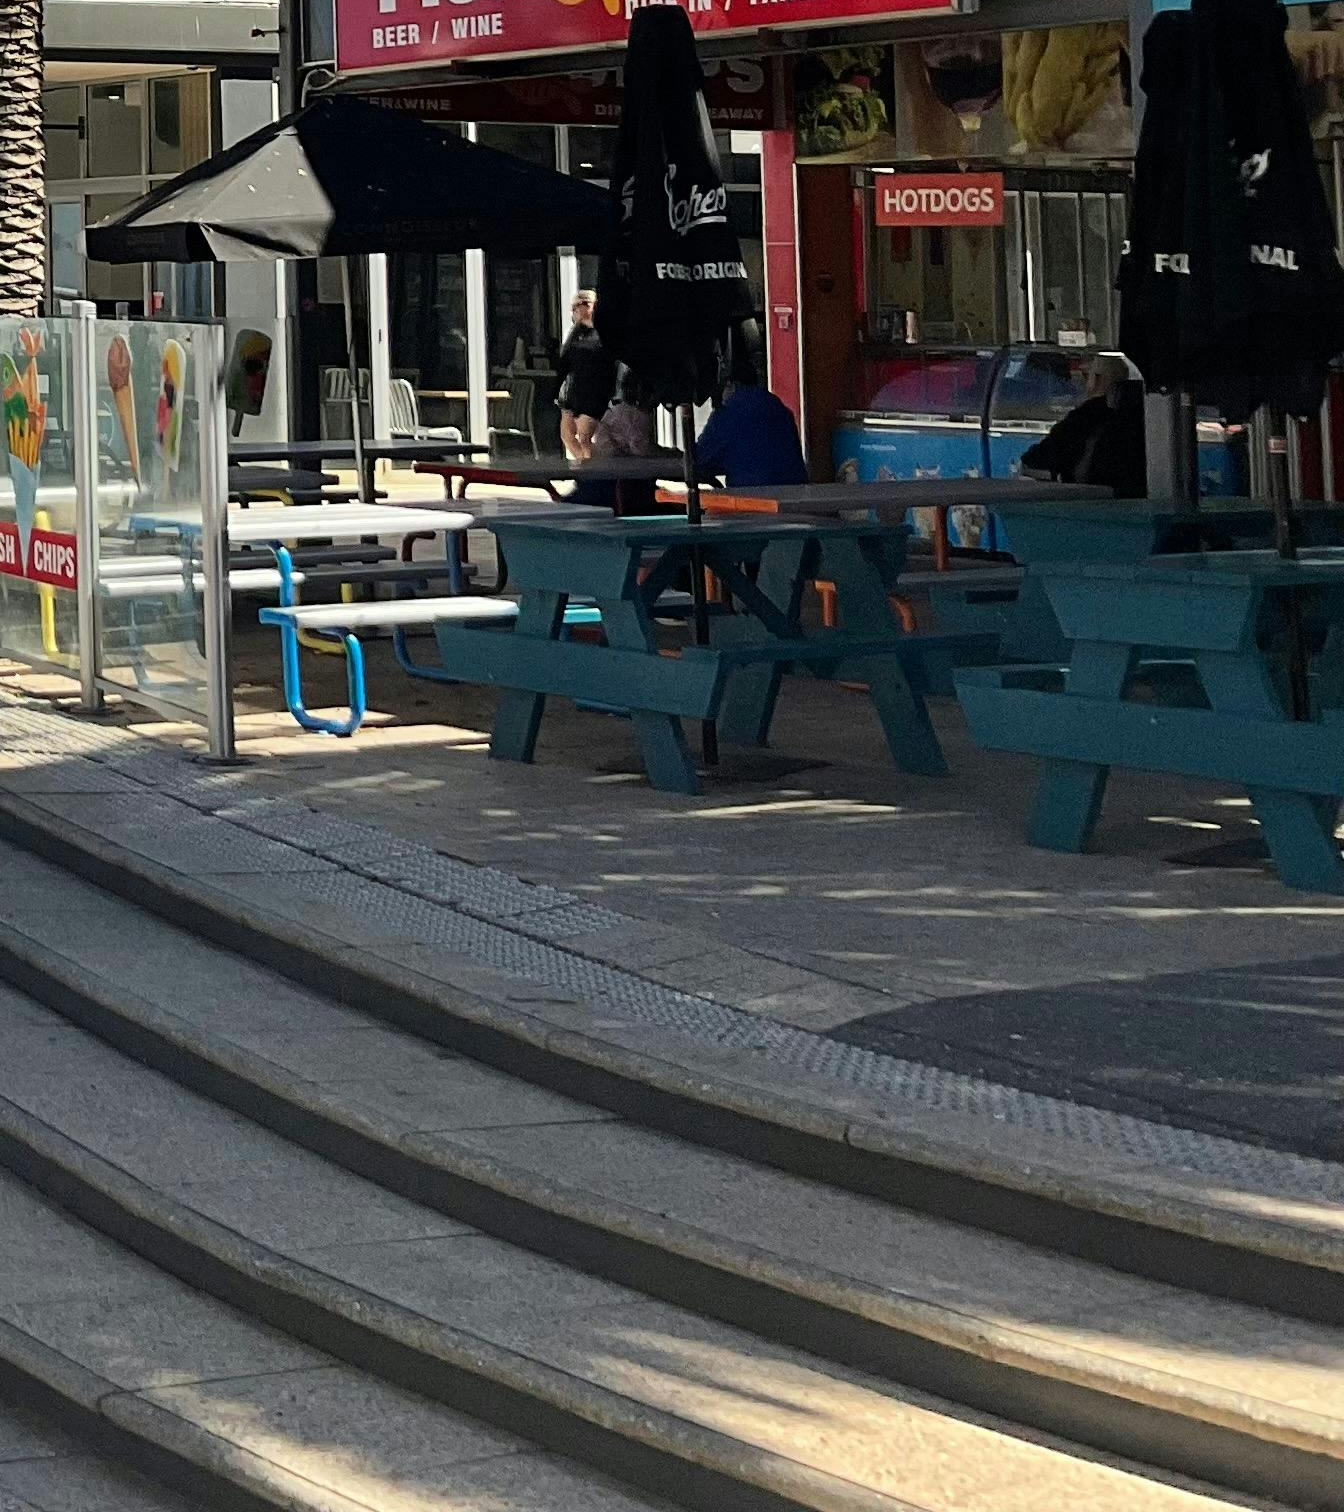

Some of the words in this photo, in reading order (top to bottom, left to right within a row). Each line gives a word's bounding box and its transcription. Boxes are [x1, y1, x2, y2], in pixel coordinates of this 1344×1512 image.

[372, 24, 420, 49] BEER
[451, 13, 503, 39] WINE
[884, 188, 995, 213] HOTDOGS
[34, 539, 74, 578] CHIPS
